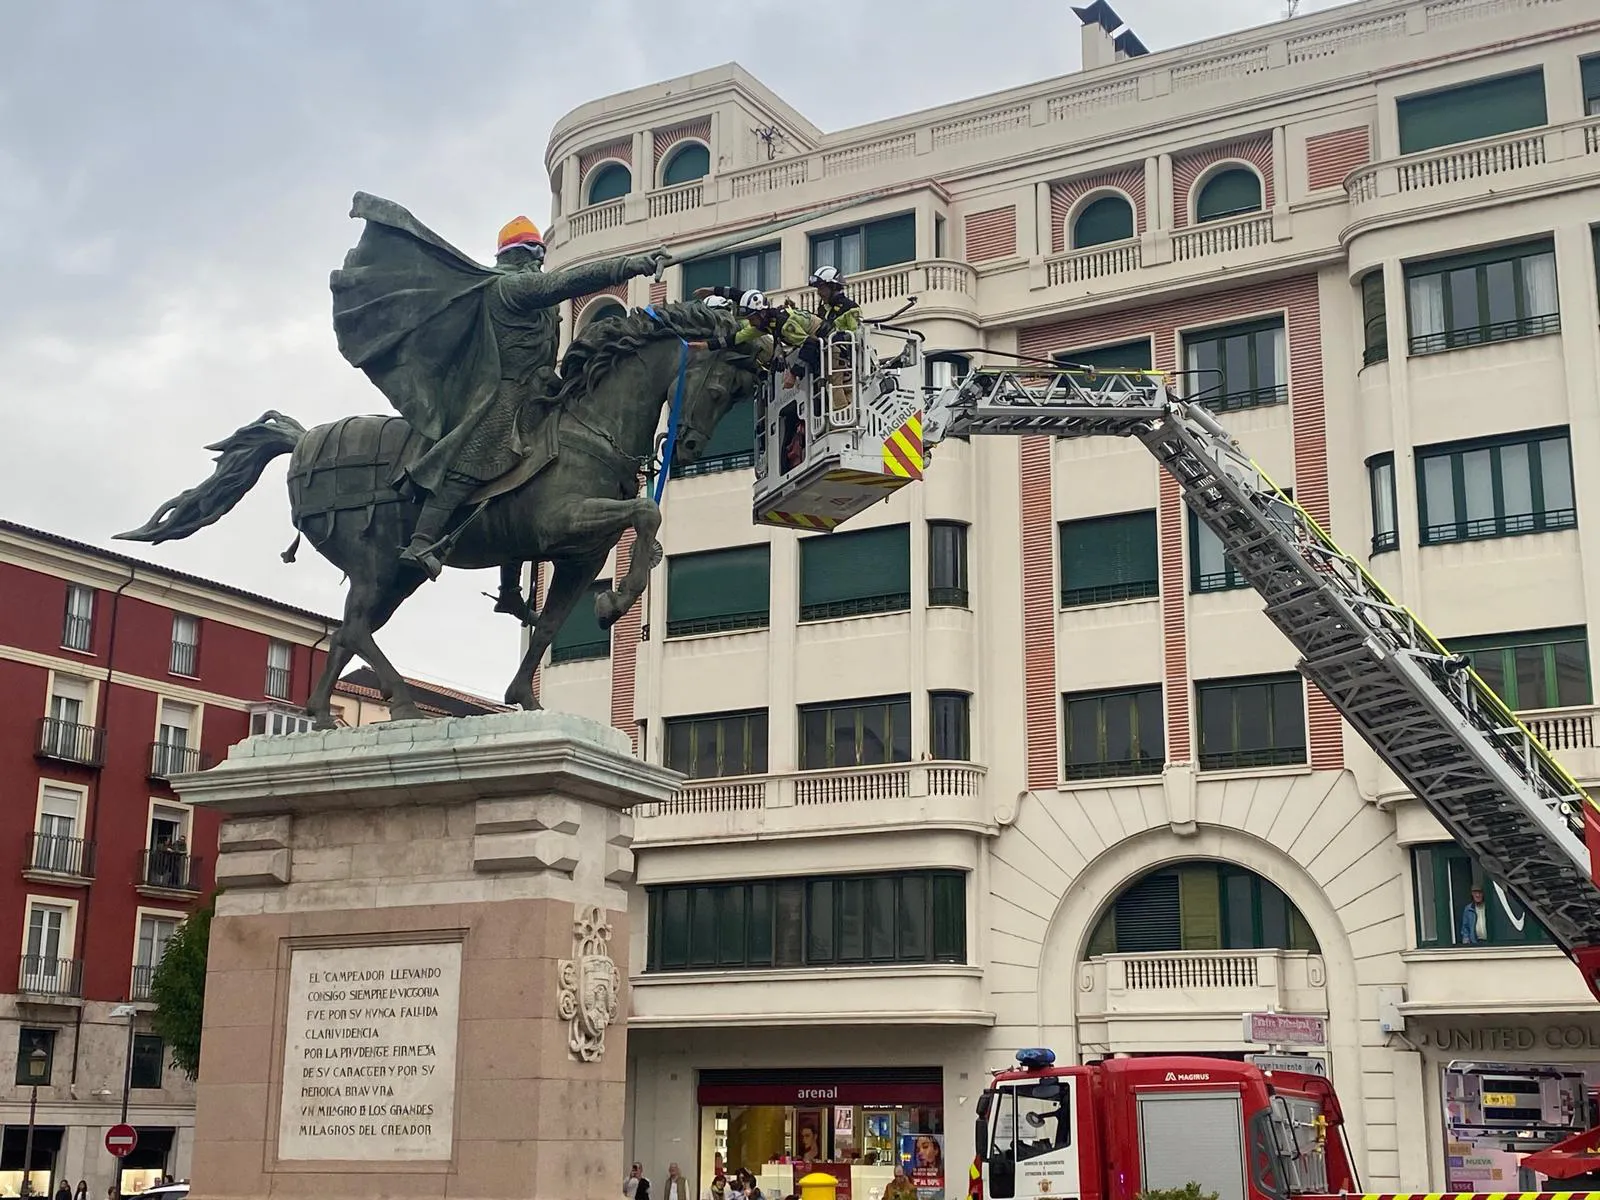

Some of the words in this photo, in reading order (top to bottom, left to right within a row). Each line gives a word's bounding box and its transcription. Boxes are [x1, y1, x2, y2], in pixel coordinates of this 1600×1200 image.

[879, 404, 916, 440] MAGIRUS
[309, 973, 320, 983] EL
[391, 968, 441, 980] LLEVANDO
[308, 990, 346, 1001] CONSIGO
[349, 988, 388, 1000] SIEMPRE
[398, 987, 440, 998] VICTORIA
[328, 1009, 347, 1020] POR
[400, 1006, 438, 1018] FALLIDA
[305, 1027, 379, 1040] CLARIVIDENCIA
[1435, 1027, 1535, 1050] UNITED
[1543, 1025, 1600, 1050] COL
[304, 1048, 322, 1059] POR
[325, 1047, 338, 1058] LA
[393, 1044, 436, 1057] FIRMEZA
[303, 1067, 314, 1078] DE
[333, 1066, 386, 1078] CARACTER
[388, 1066, 396, 1076] Y
[397, 1065, 417, 1076] POR
[1178, 1073, 1210, 1081] MAGIRUS
[798, 1086, 838, 1099] arenal
[317, 1105, 357, 1117] MILAGRO
[368, 1104, 387, 1116] LOS
[390, 1104, 434, 1116] GRANDES
[299, 1125, 356, 1136] MILAGROS
[358, 1125, 377, 1136] DEL
[380, 1124, 432, 1136] CREADOR
